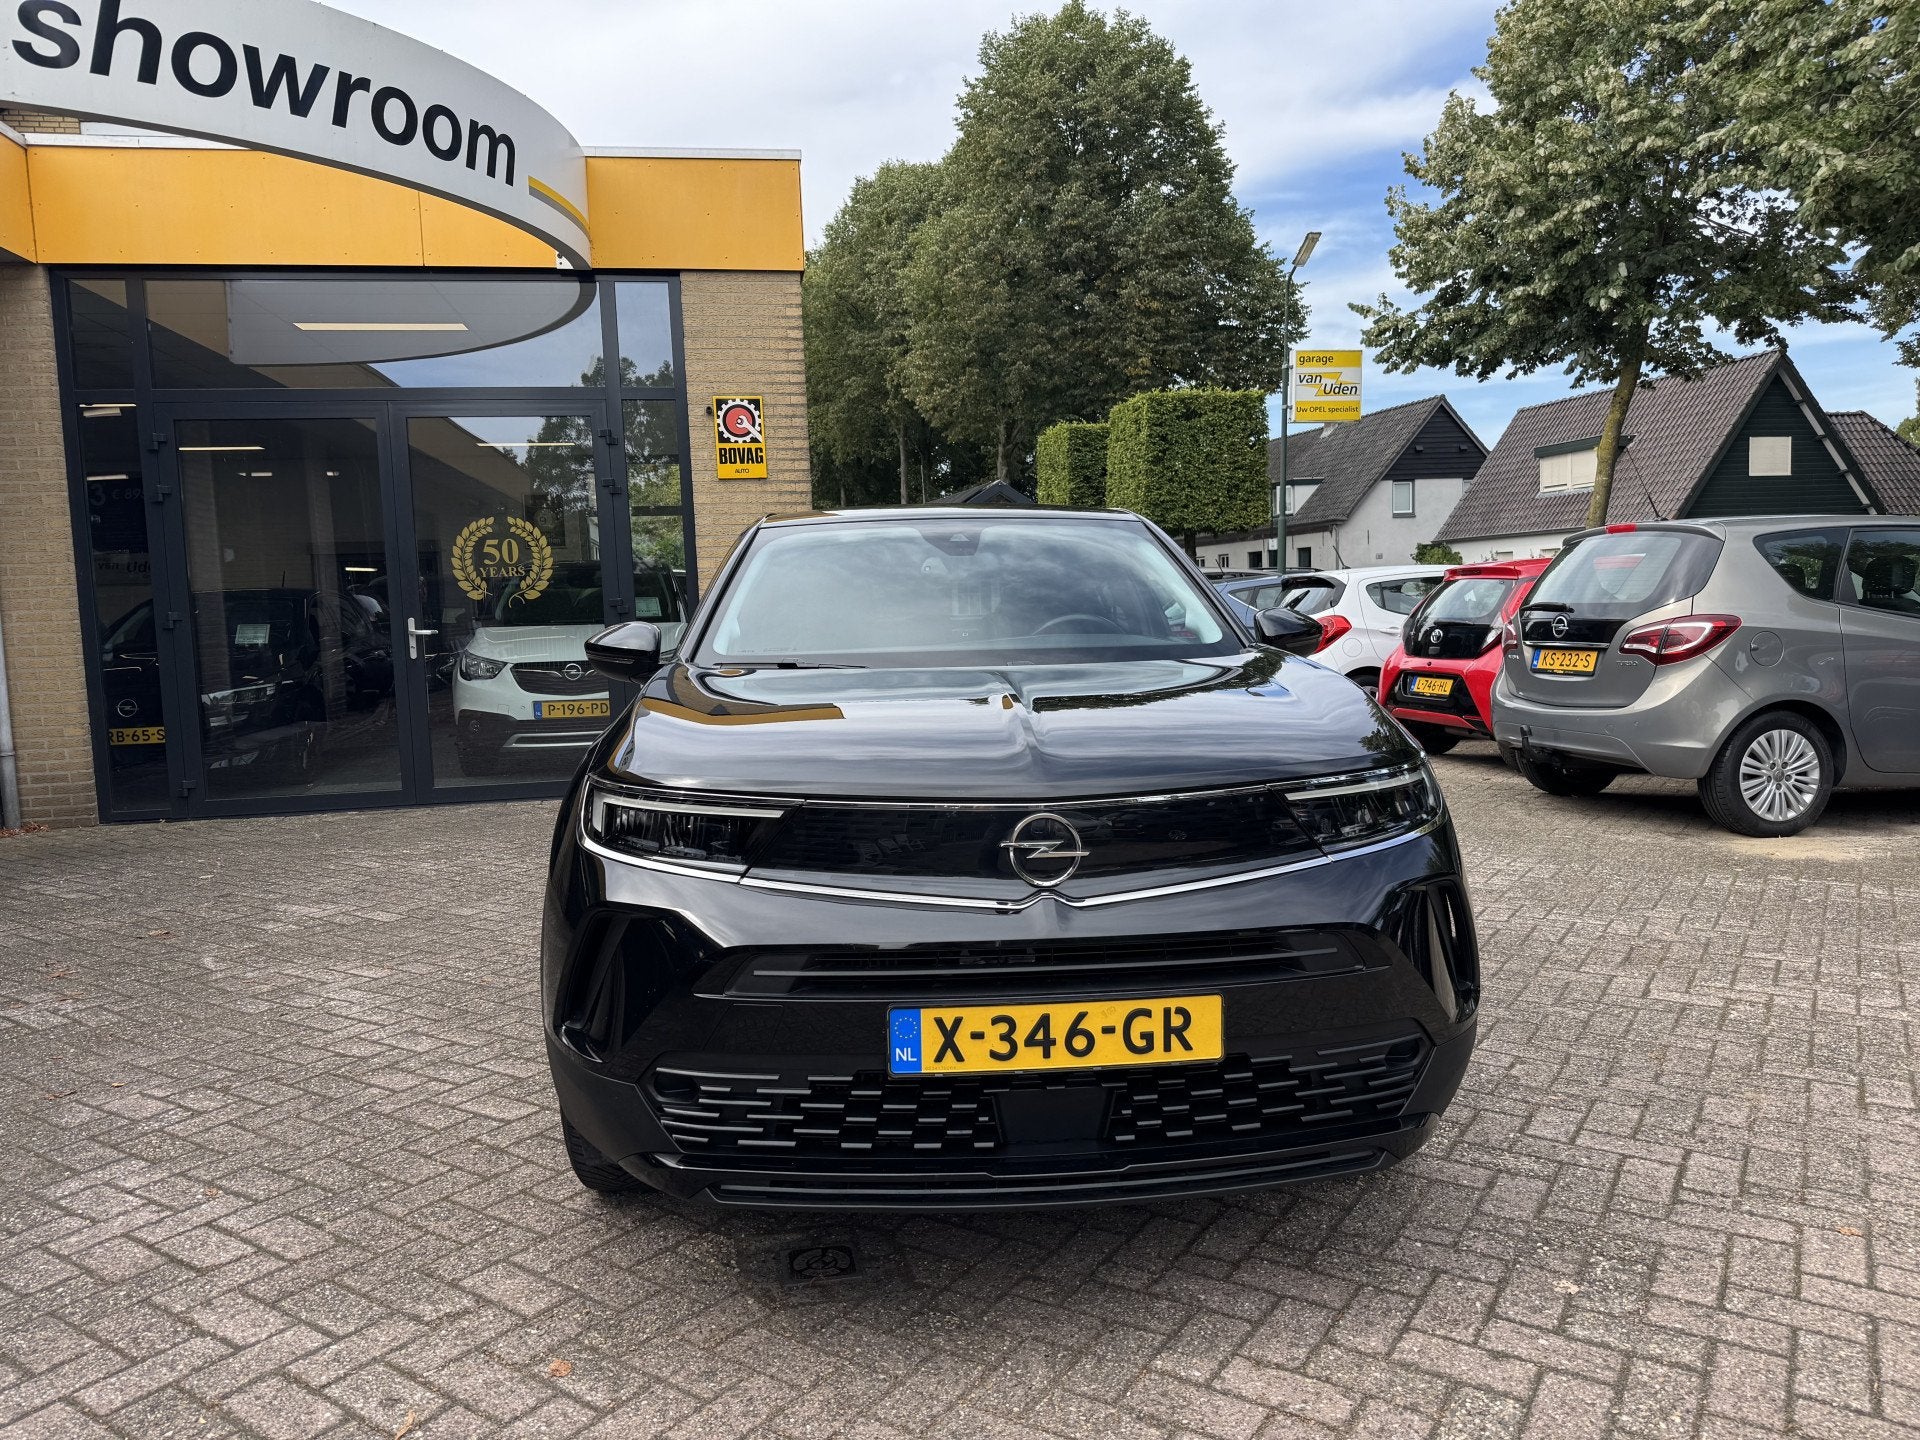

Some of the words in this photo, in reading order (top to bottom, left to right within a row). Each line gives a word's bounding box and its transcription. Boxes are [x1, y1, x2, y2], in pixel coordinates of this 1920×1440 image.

[12, 0, 516, 187] showroom
[1298, 355, 1334, 365] garage
[1298, 374, 1323, 384] van
[1323, 383, 1358, 395] Uden
[1328, 406, 1359, 414] specialist
[718, 447, 764, 465] BOVAG
[482, 538, 519, 565] 50
[479, 565, 526, 578] YEARS
[1541, 651, 1592, 668] KS-232-S
[1416, 678, 1448, 693] L-746-HL
[547, 702, 609, 716] P-196-PD
[895, 1047, 917, 1062] NL
[932, 1005, 1194, 1063] X-346-GR
